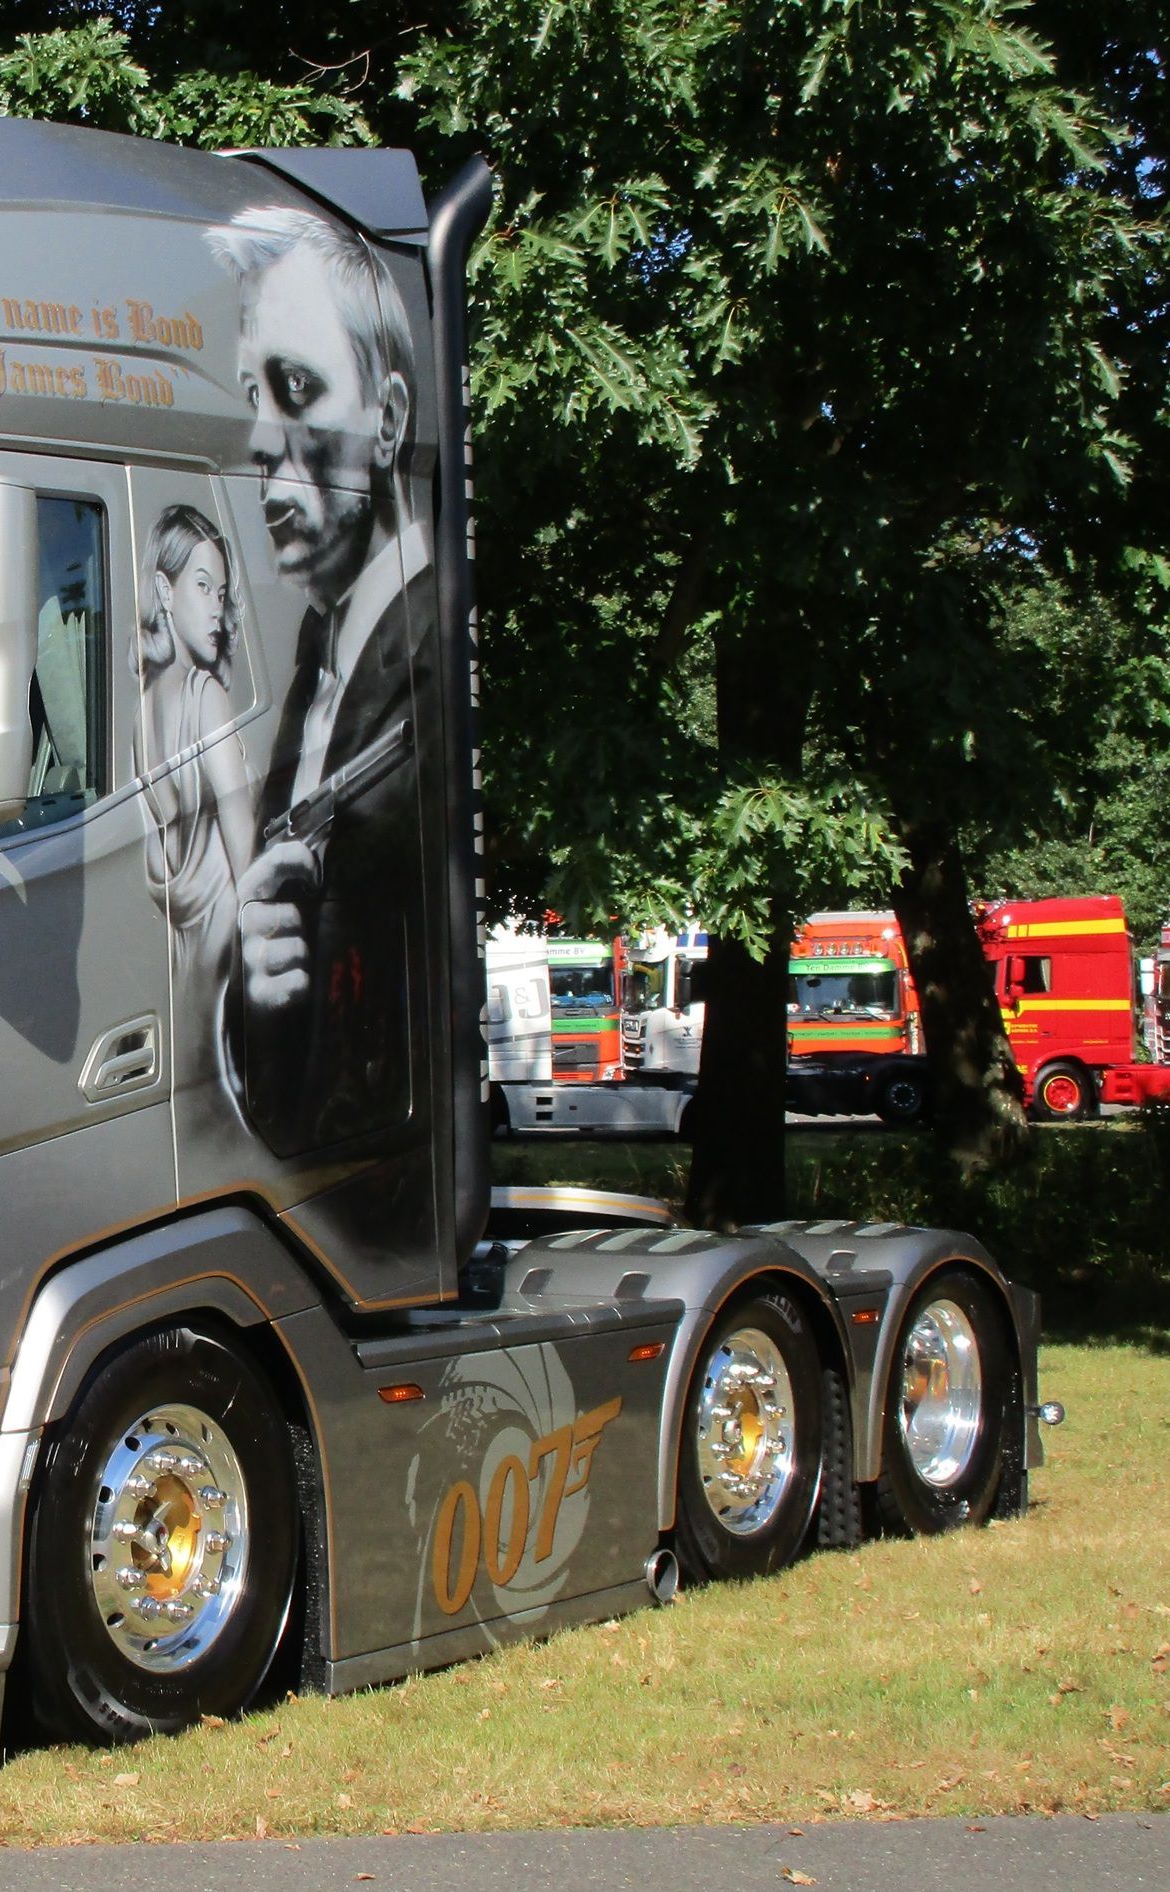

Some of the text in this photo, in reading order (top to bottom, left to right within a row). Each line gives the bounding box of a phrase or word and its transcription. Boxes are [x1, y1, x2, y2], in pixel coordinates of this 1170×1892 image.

[1, 297, 83, 336] name
[91, 298, 120, 339] is
[125, 298, 204, 350] Bond
[433, 1423, 576, 1615] 007
